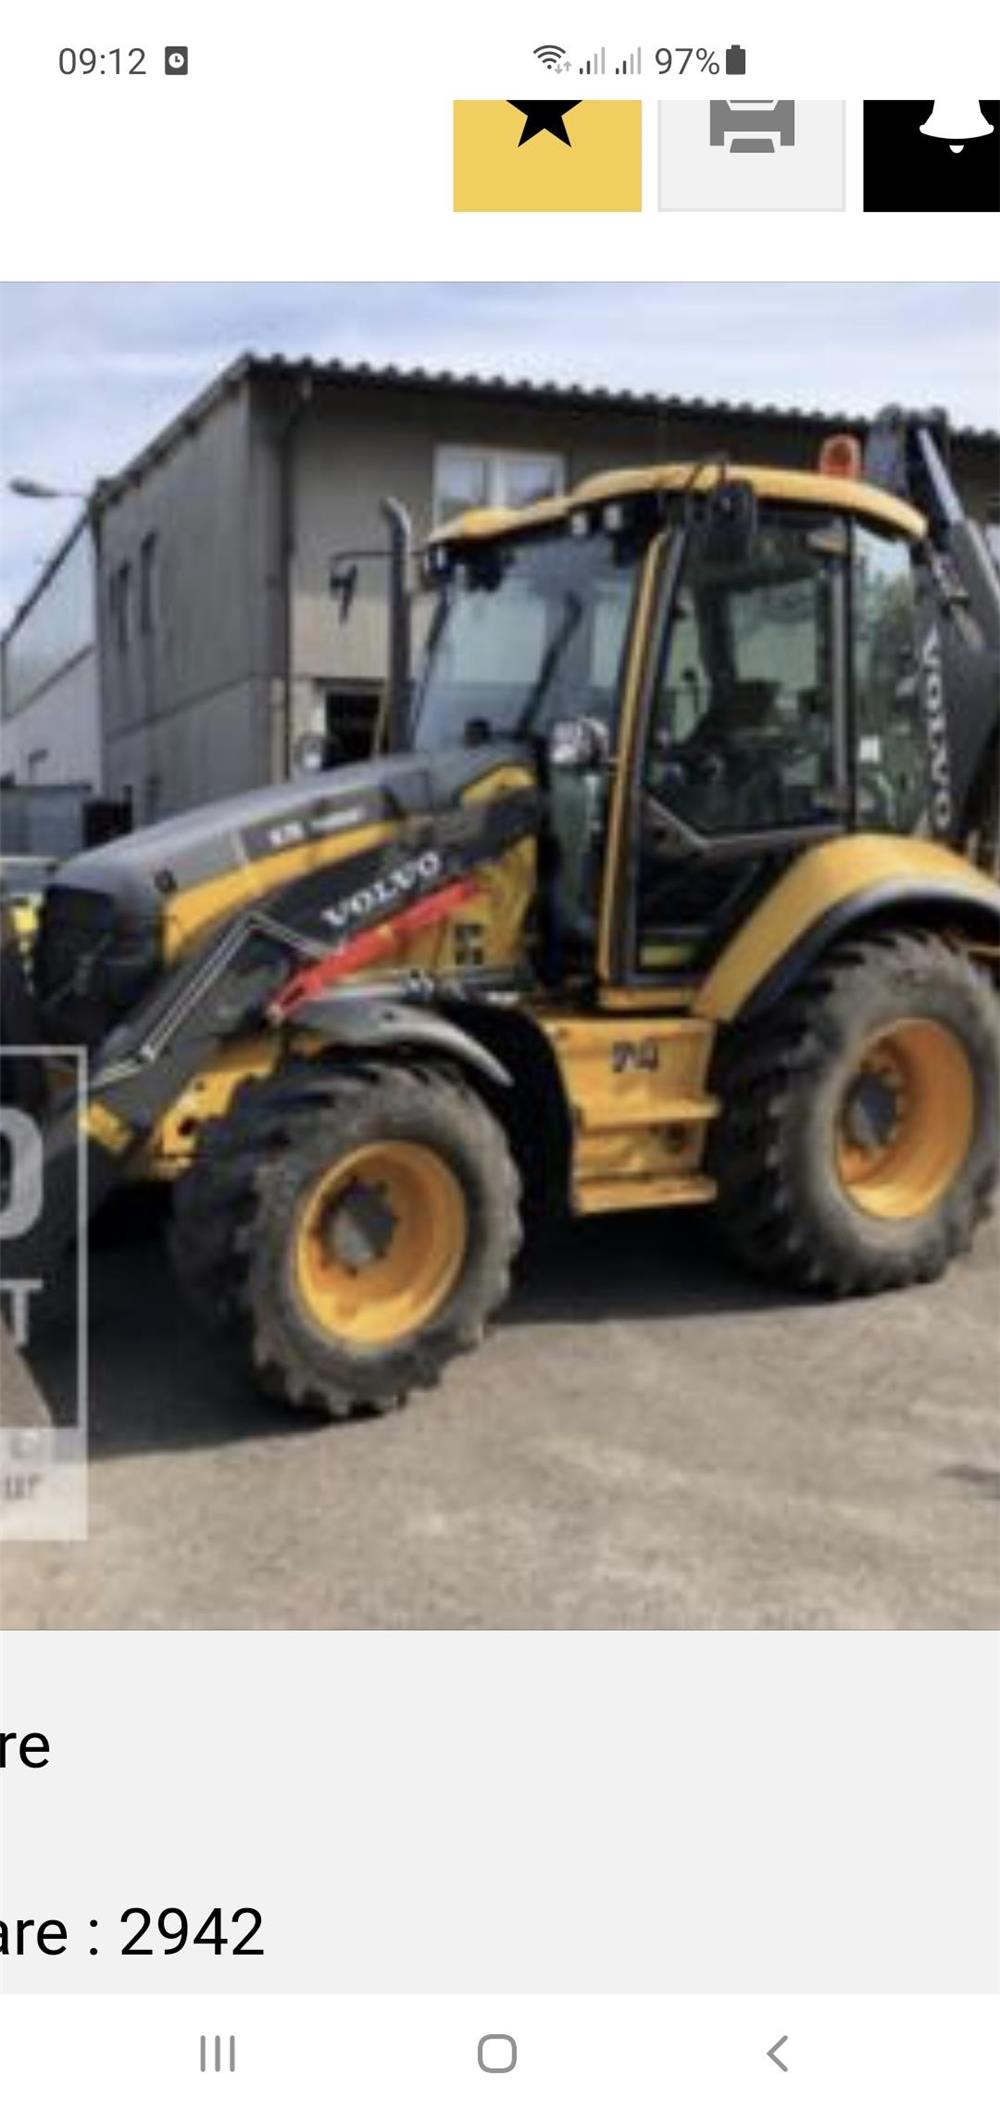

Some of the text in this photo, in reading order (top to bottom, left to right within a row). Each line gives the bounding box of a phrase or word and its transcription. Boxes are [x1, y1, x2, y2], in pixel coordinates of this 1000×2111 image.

[58, 47, 147, 75] 09:12
[655, 47, 720, 75] 97%
[921, 622, 951, 832] VOLVO
[320, 851, 441, 927] VOLVO
[0, 1732, 50, 1768] re
[120, 1907, 265, 1956] 2942
